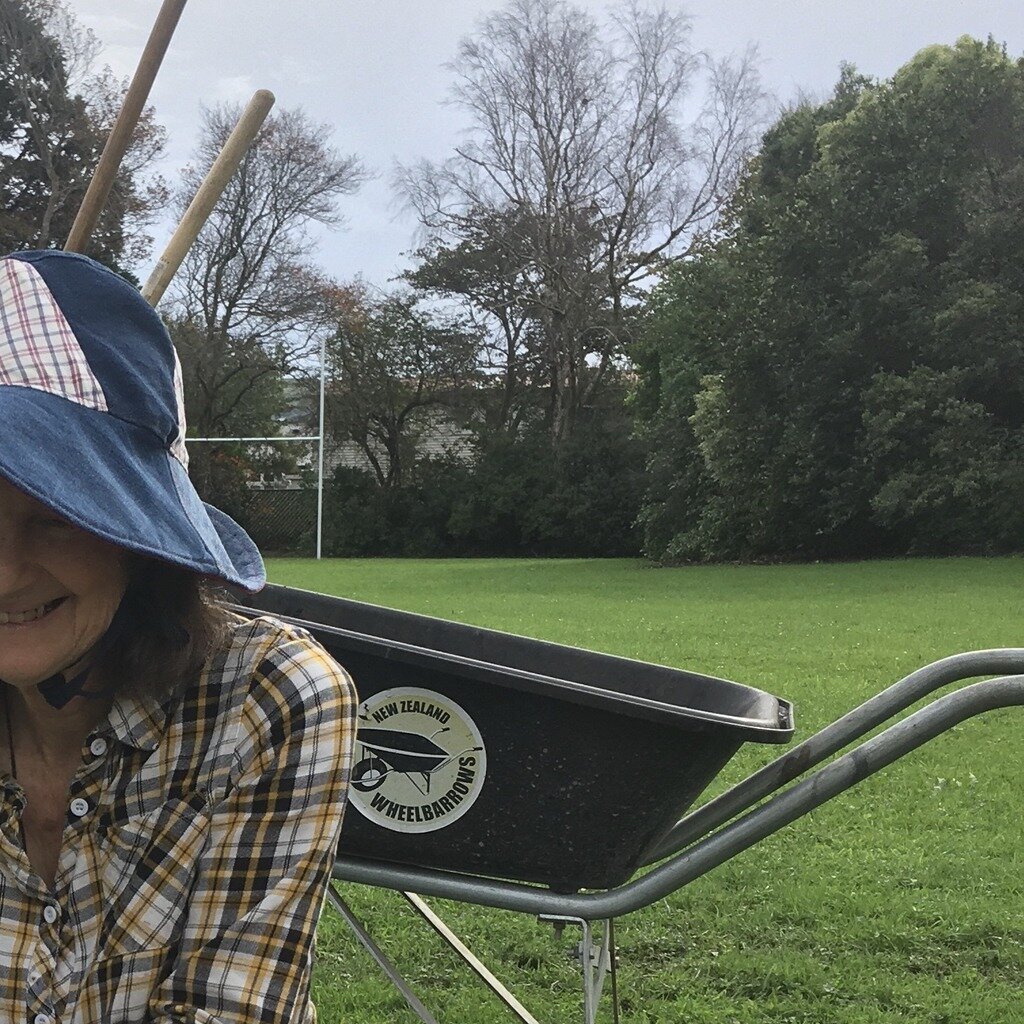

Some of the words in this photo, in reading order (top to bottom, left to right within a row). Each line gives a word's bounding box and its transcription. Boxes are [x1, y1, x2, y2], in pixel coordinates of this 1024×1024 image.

[372, 702, 398, 723] NEW
[400, 700, 451, 724] ZEALAND
[370, 756, 476, 822] WHEELBARROWS
